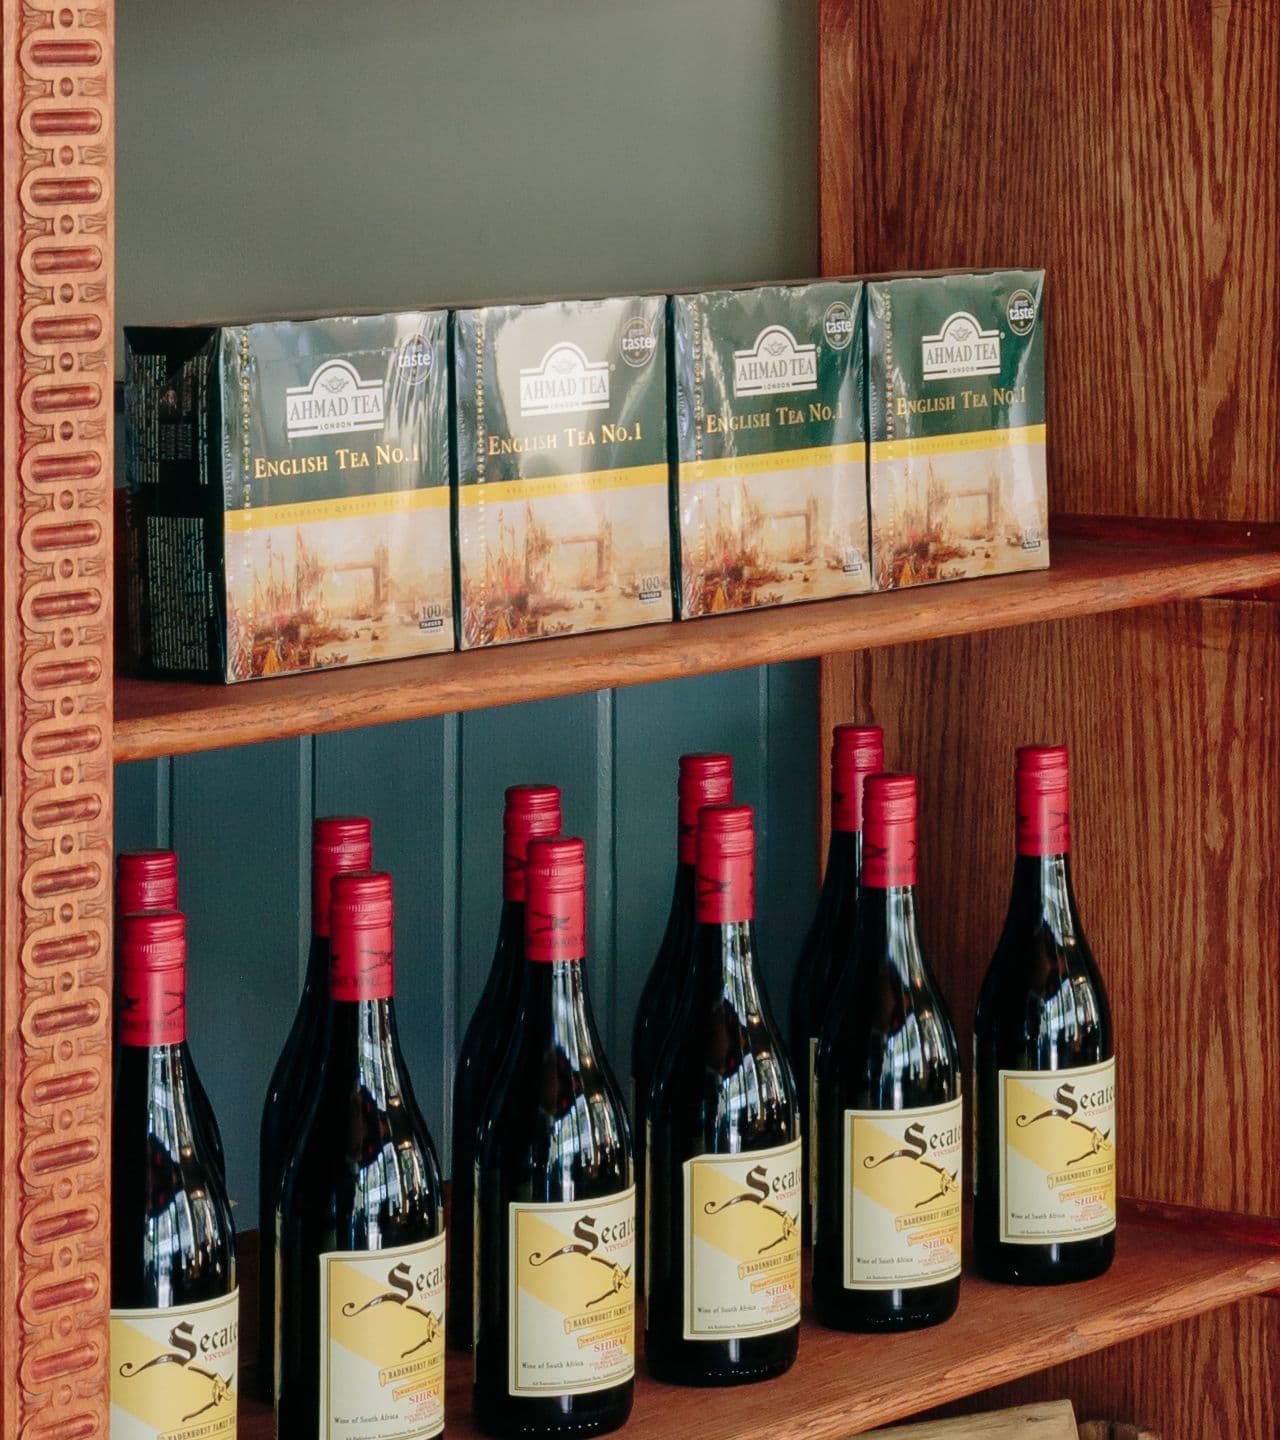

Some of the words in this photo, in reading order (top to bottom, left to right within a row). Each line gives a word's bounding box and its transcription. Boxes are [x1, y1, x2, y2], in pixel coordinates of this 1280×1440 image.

[1008, 307, 1034, 320] taste
[825, 320, 854, 334] taste
[622, 335, 655, 351] taste
[398, 349, 432, 368] taste
[926, 345, 972, 366] AHMAD
[974, 343, 998, 361] TEA
[738, 360, 786, 382] AHMAD
[788, 357, 815, 376] TEA
[523, 379, 576, 401] AHMAD
[579, 375, 607, 395] TEA
[290, 397, 349, 421] AHMAD
[350, 394, 381, 415] TEA
[896, 396, 956, 416] ENGLISH
[960, 390, 988, 409] TEA
[706, 412, 770, 433] ENGLISH
[775, 406, 804, 426] TEA
[488, 433, 558, 456] ENGLISH
[564, 427, 596, 447] TEA
[254, 455, 328, 479] ENGLISH
[335, 448, 370, 470] TEA
[642, 576, 660, 591] 100
[422, 604, 441, 620] 100
[593, 1335, 628, 1353] SHIRAZ
[409, 1385, 441, 1405] SHIRAZ
